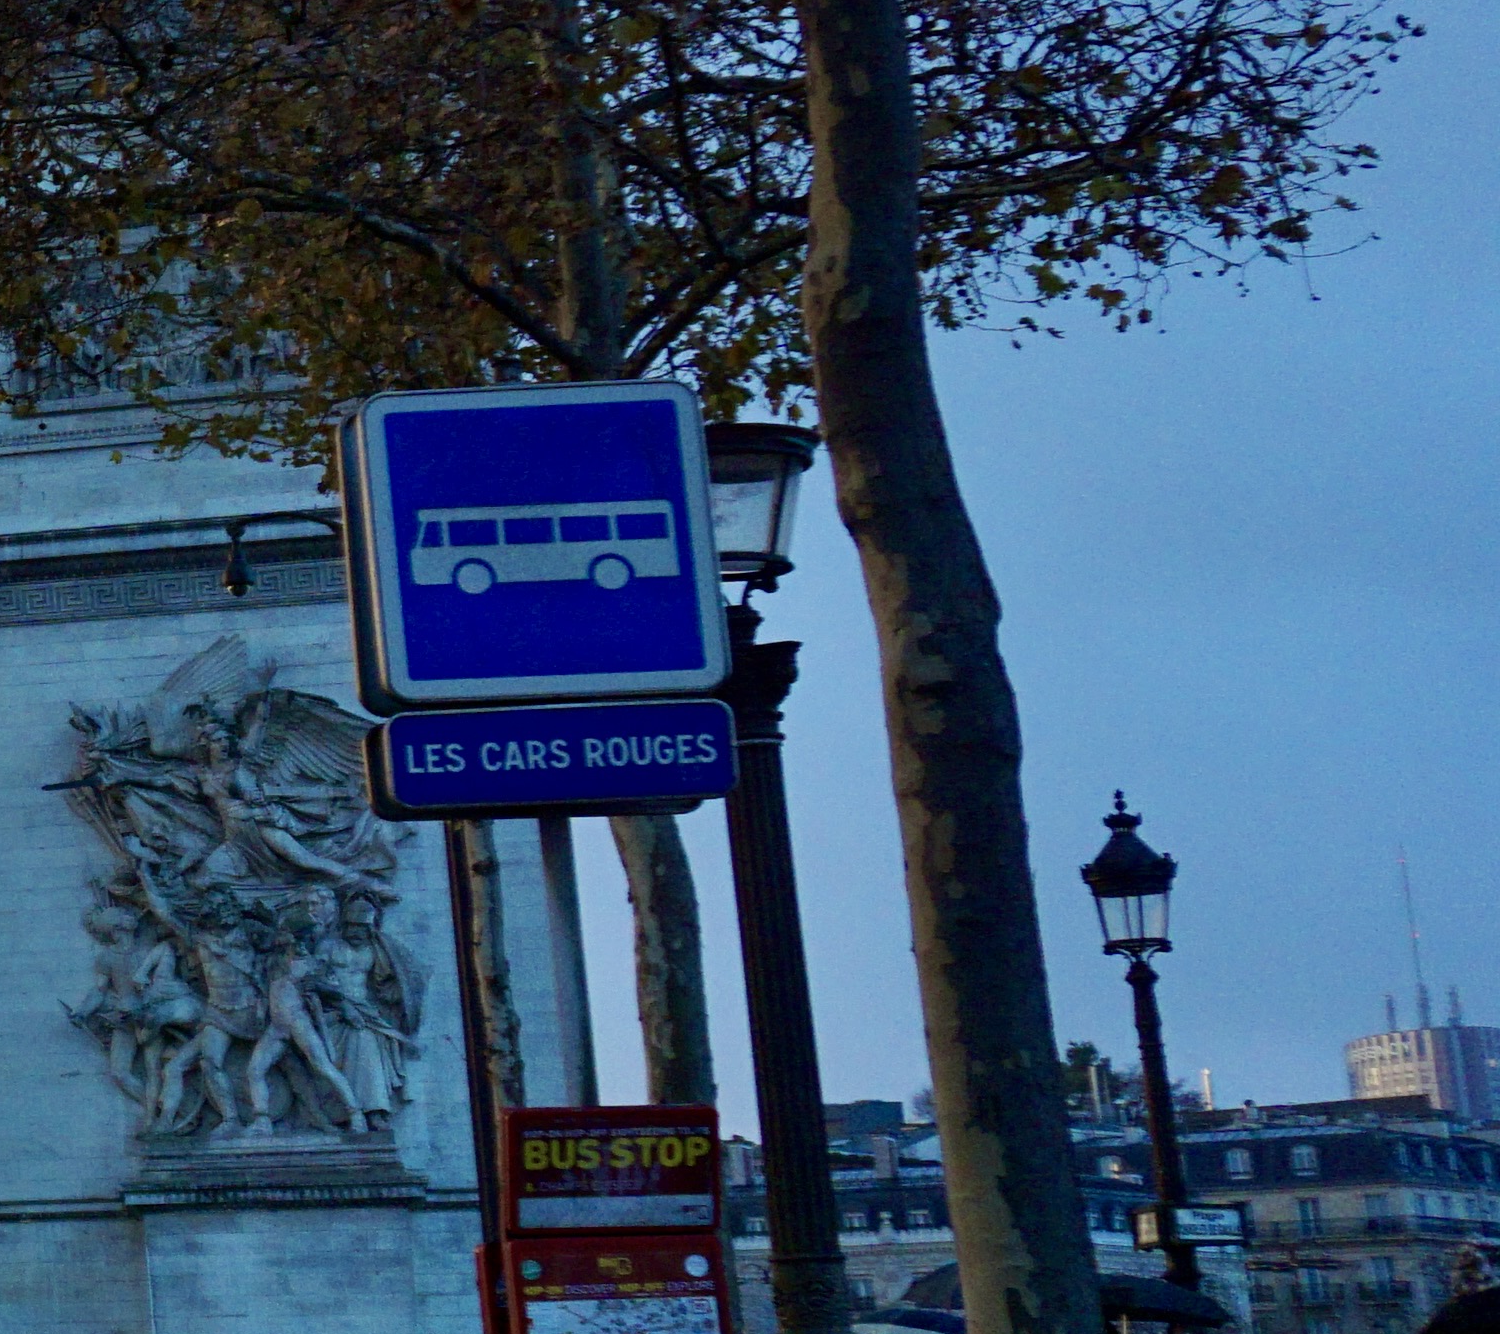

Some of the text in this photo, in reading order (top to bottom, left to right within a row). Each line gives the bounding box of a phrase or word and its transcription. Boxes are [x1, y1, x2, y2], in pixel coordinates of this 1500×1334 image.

[404, 733, 718, 774] LES CARS ROUGES
[523, 1136, 711, 1171] BUS STOP
